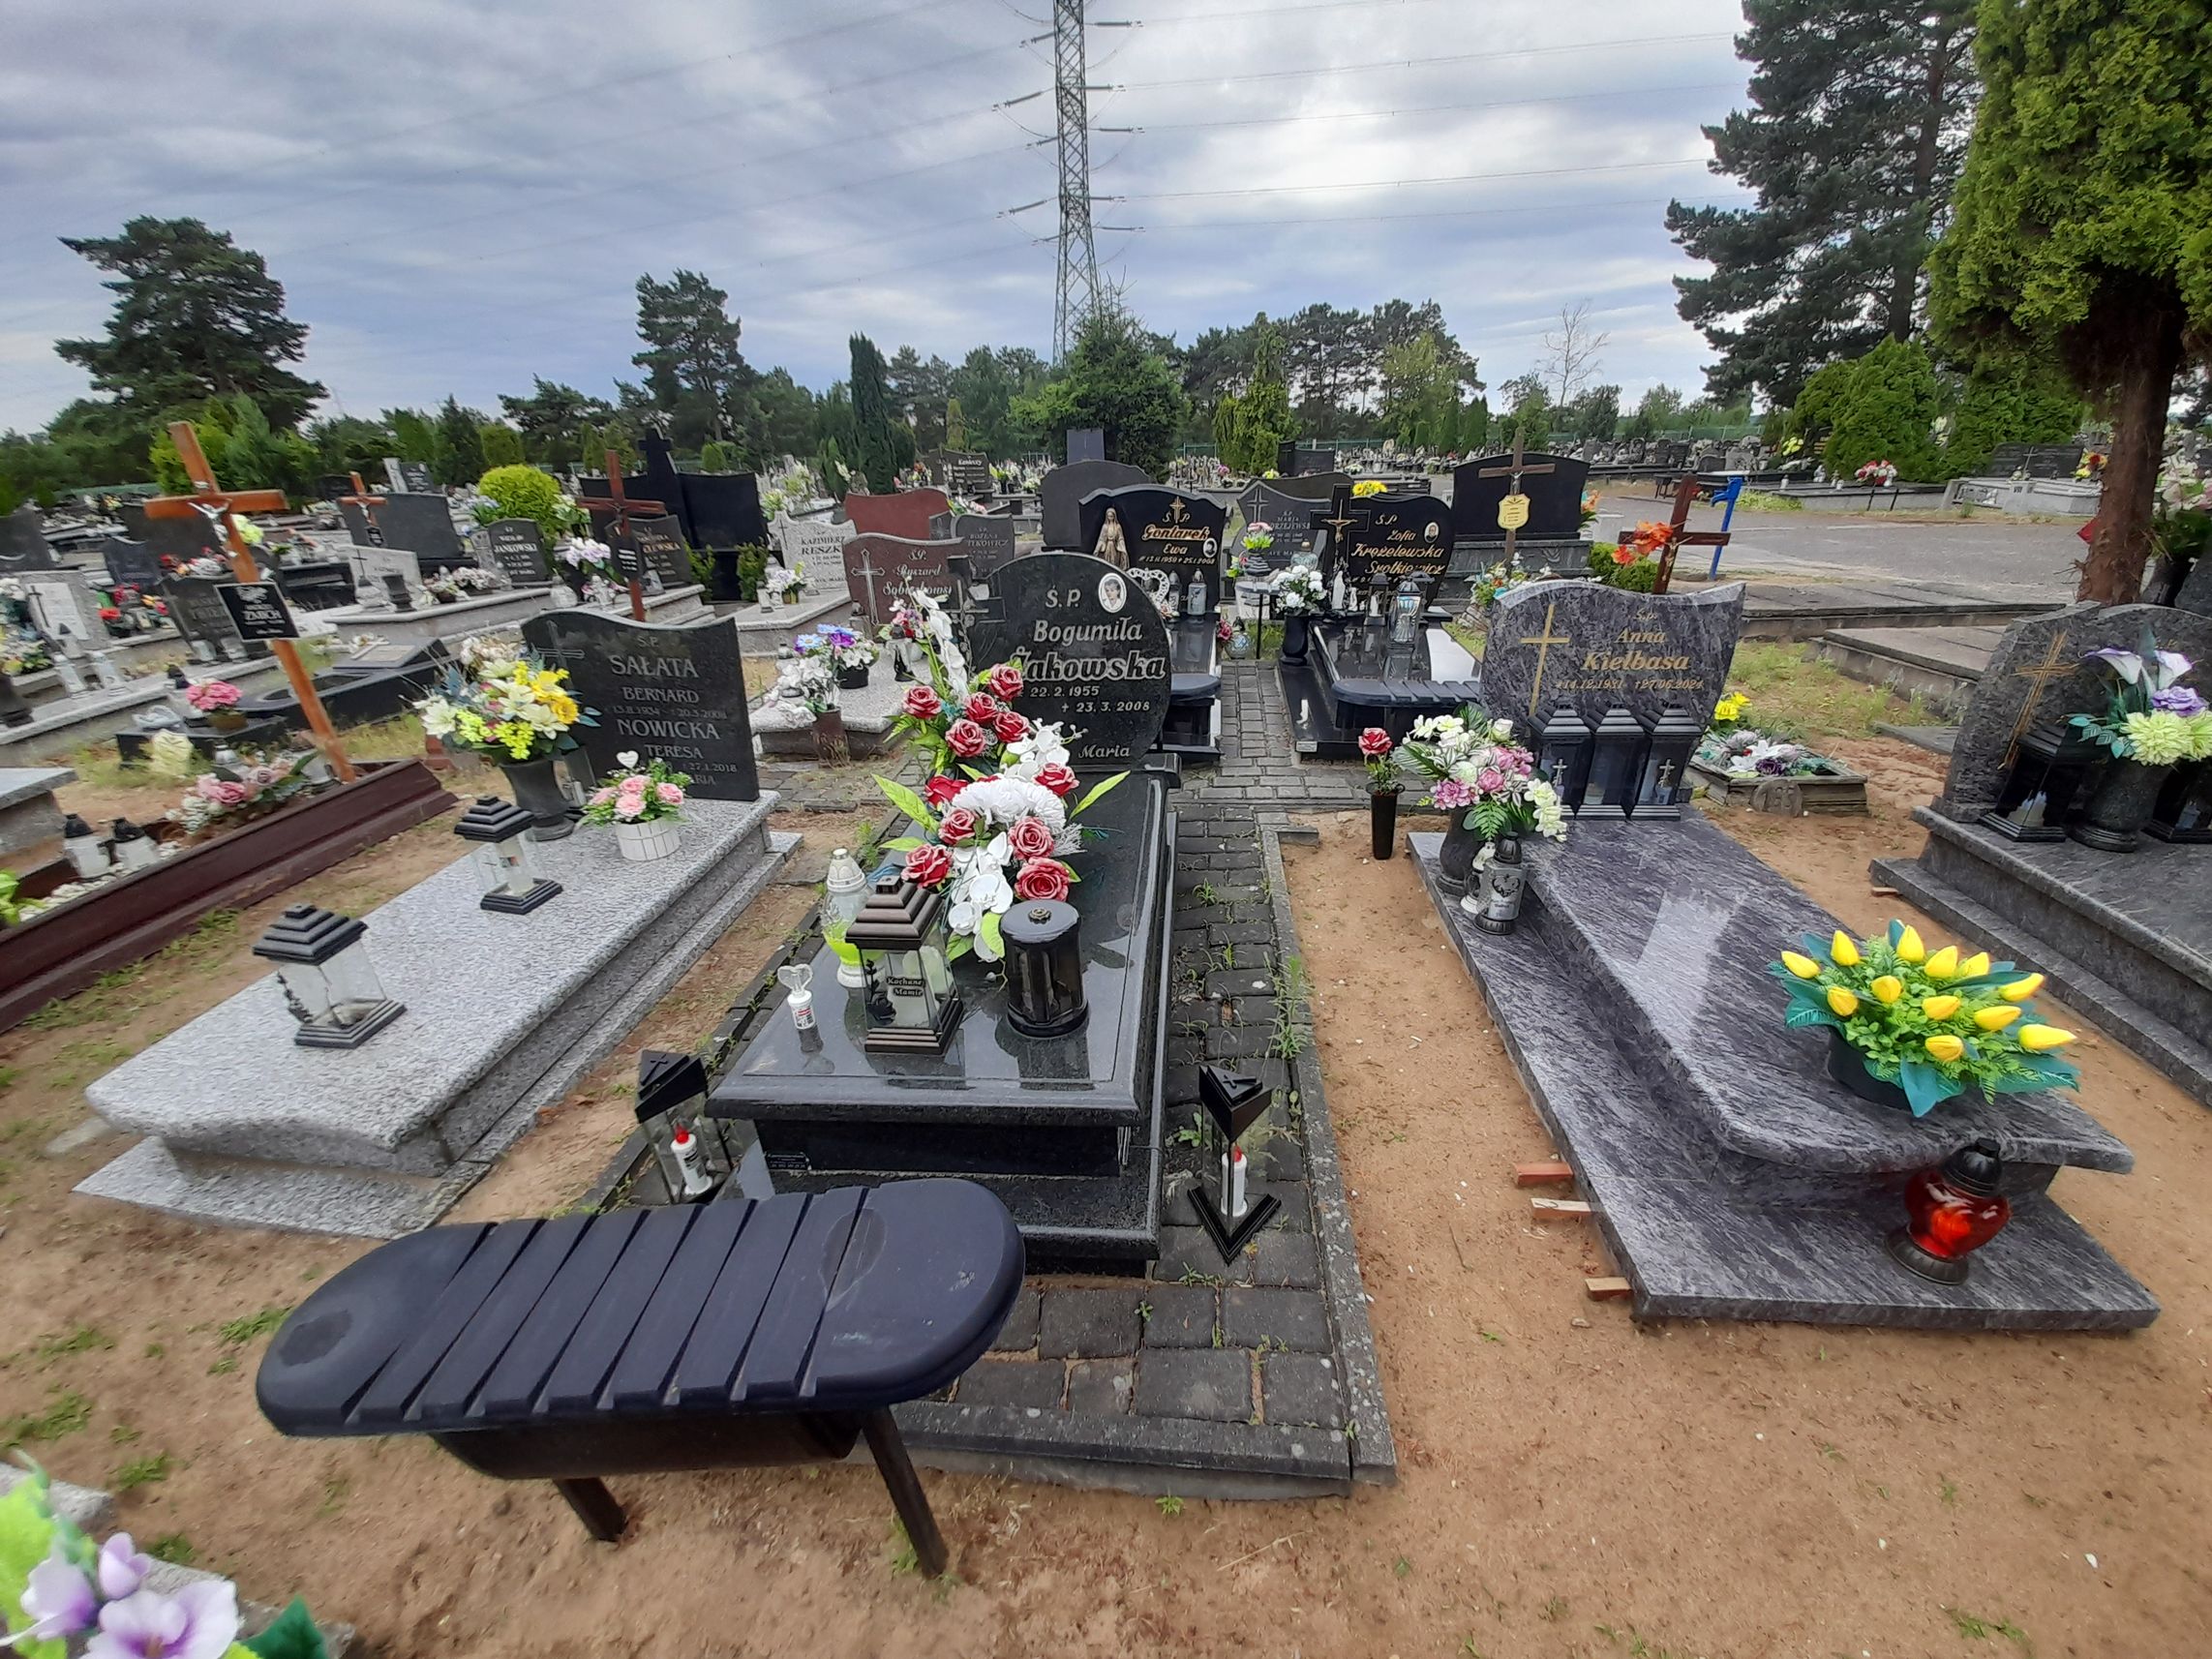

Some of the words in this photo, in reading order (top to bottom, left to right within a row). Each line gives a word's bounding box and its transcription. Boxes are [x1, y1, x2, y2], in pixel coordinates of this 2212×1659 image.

[1141, 524, 1210, 541] Gontarek
[802, 545, 841, 556] RESZK
[1163, 543, 1188, 555] Ewa
[895, 564, 942, 578] Ryszard
[1033, 616, 1142, 647] Bogumiła
[1614, 627, 1666, 644] Anna
[609, 654, 700, 679] SAŁATA
[1010, 646, 1167, 682] Żakowska
[622, 686, 700, 704] BERNARD
[617, 718, 721, 740] NOWICKA
[644, 743, 705, 760] TERESA
[1078, 744, 1131, 760] Maria
